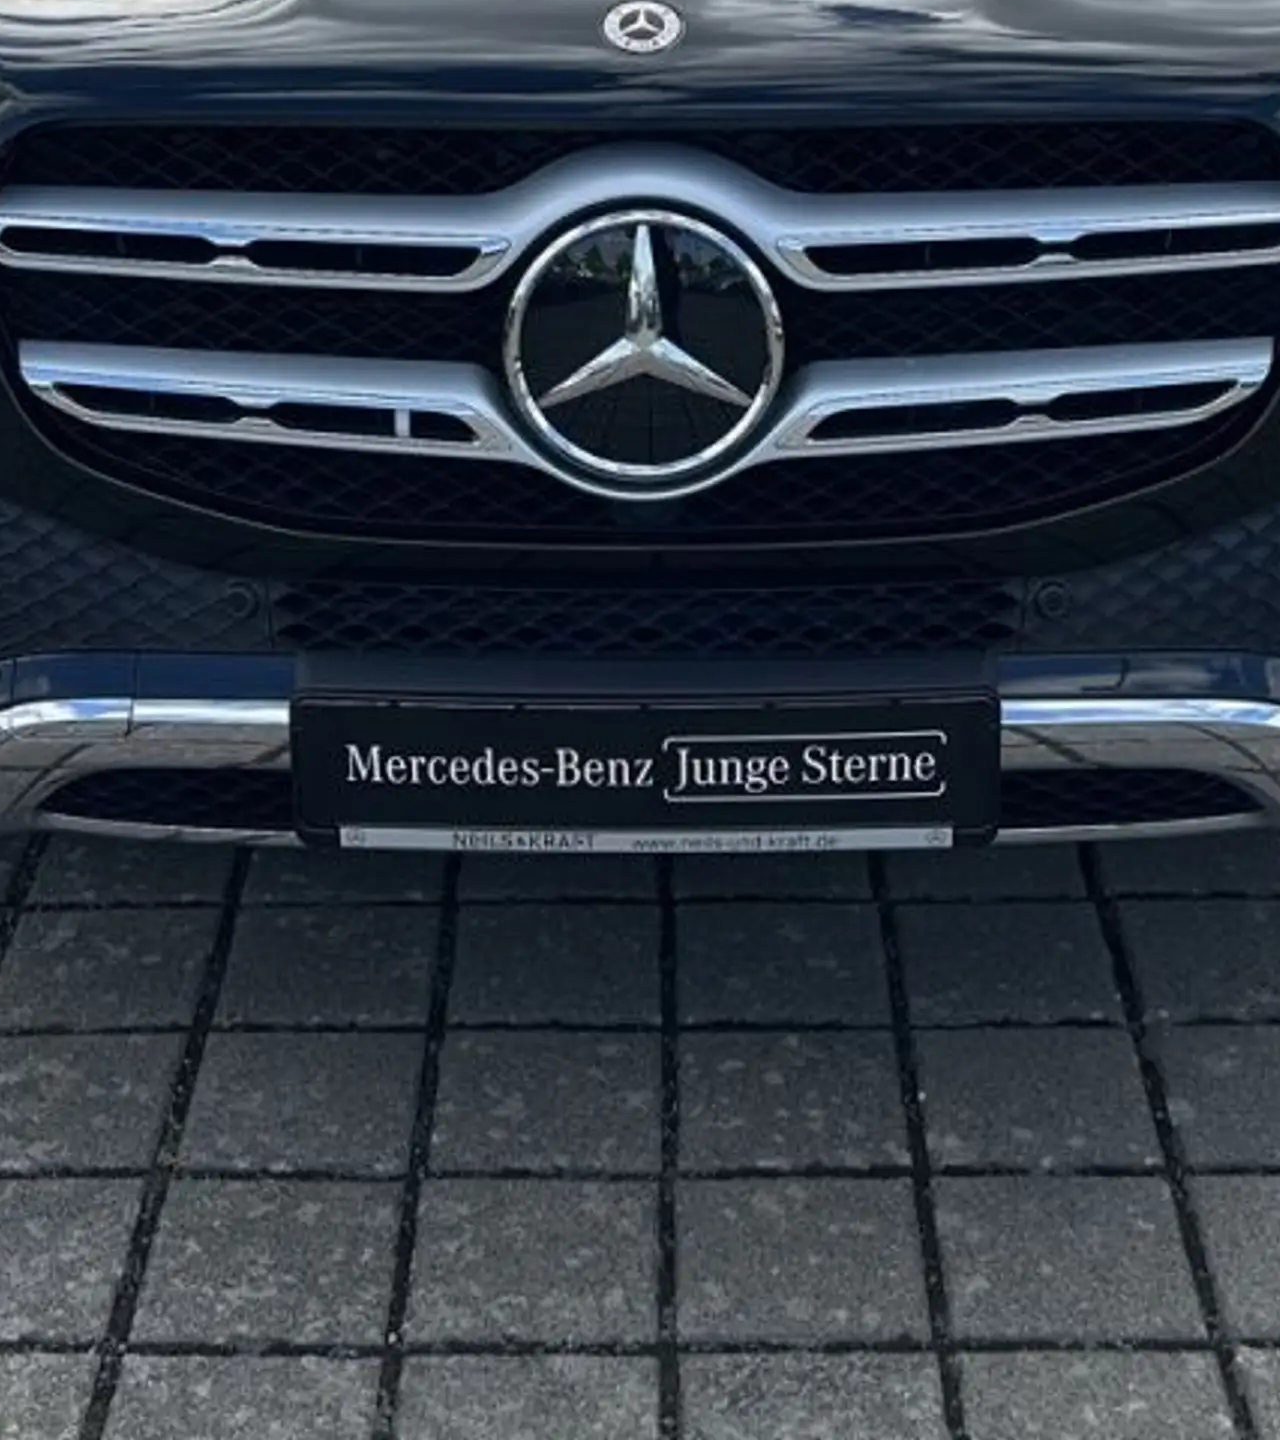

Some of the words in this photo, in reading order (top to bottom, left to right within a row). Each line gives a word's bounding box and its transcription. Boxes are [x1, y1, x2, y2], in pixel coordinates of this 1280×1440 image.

[345, 744, 654, 787] Mercedes-Benz
[674, 747, 790, 793] Junge
[801, 744, 936, 784] Sterne
